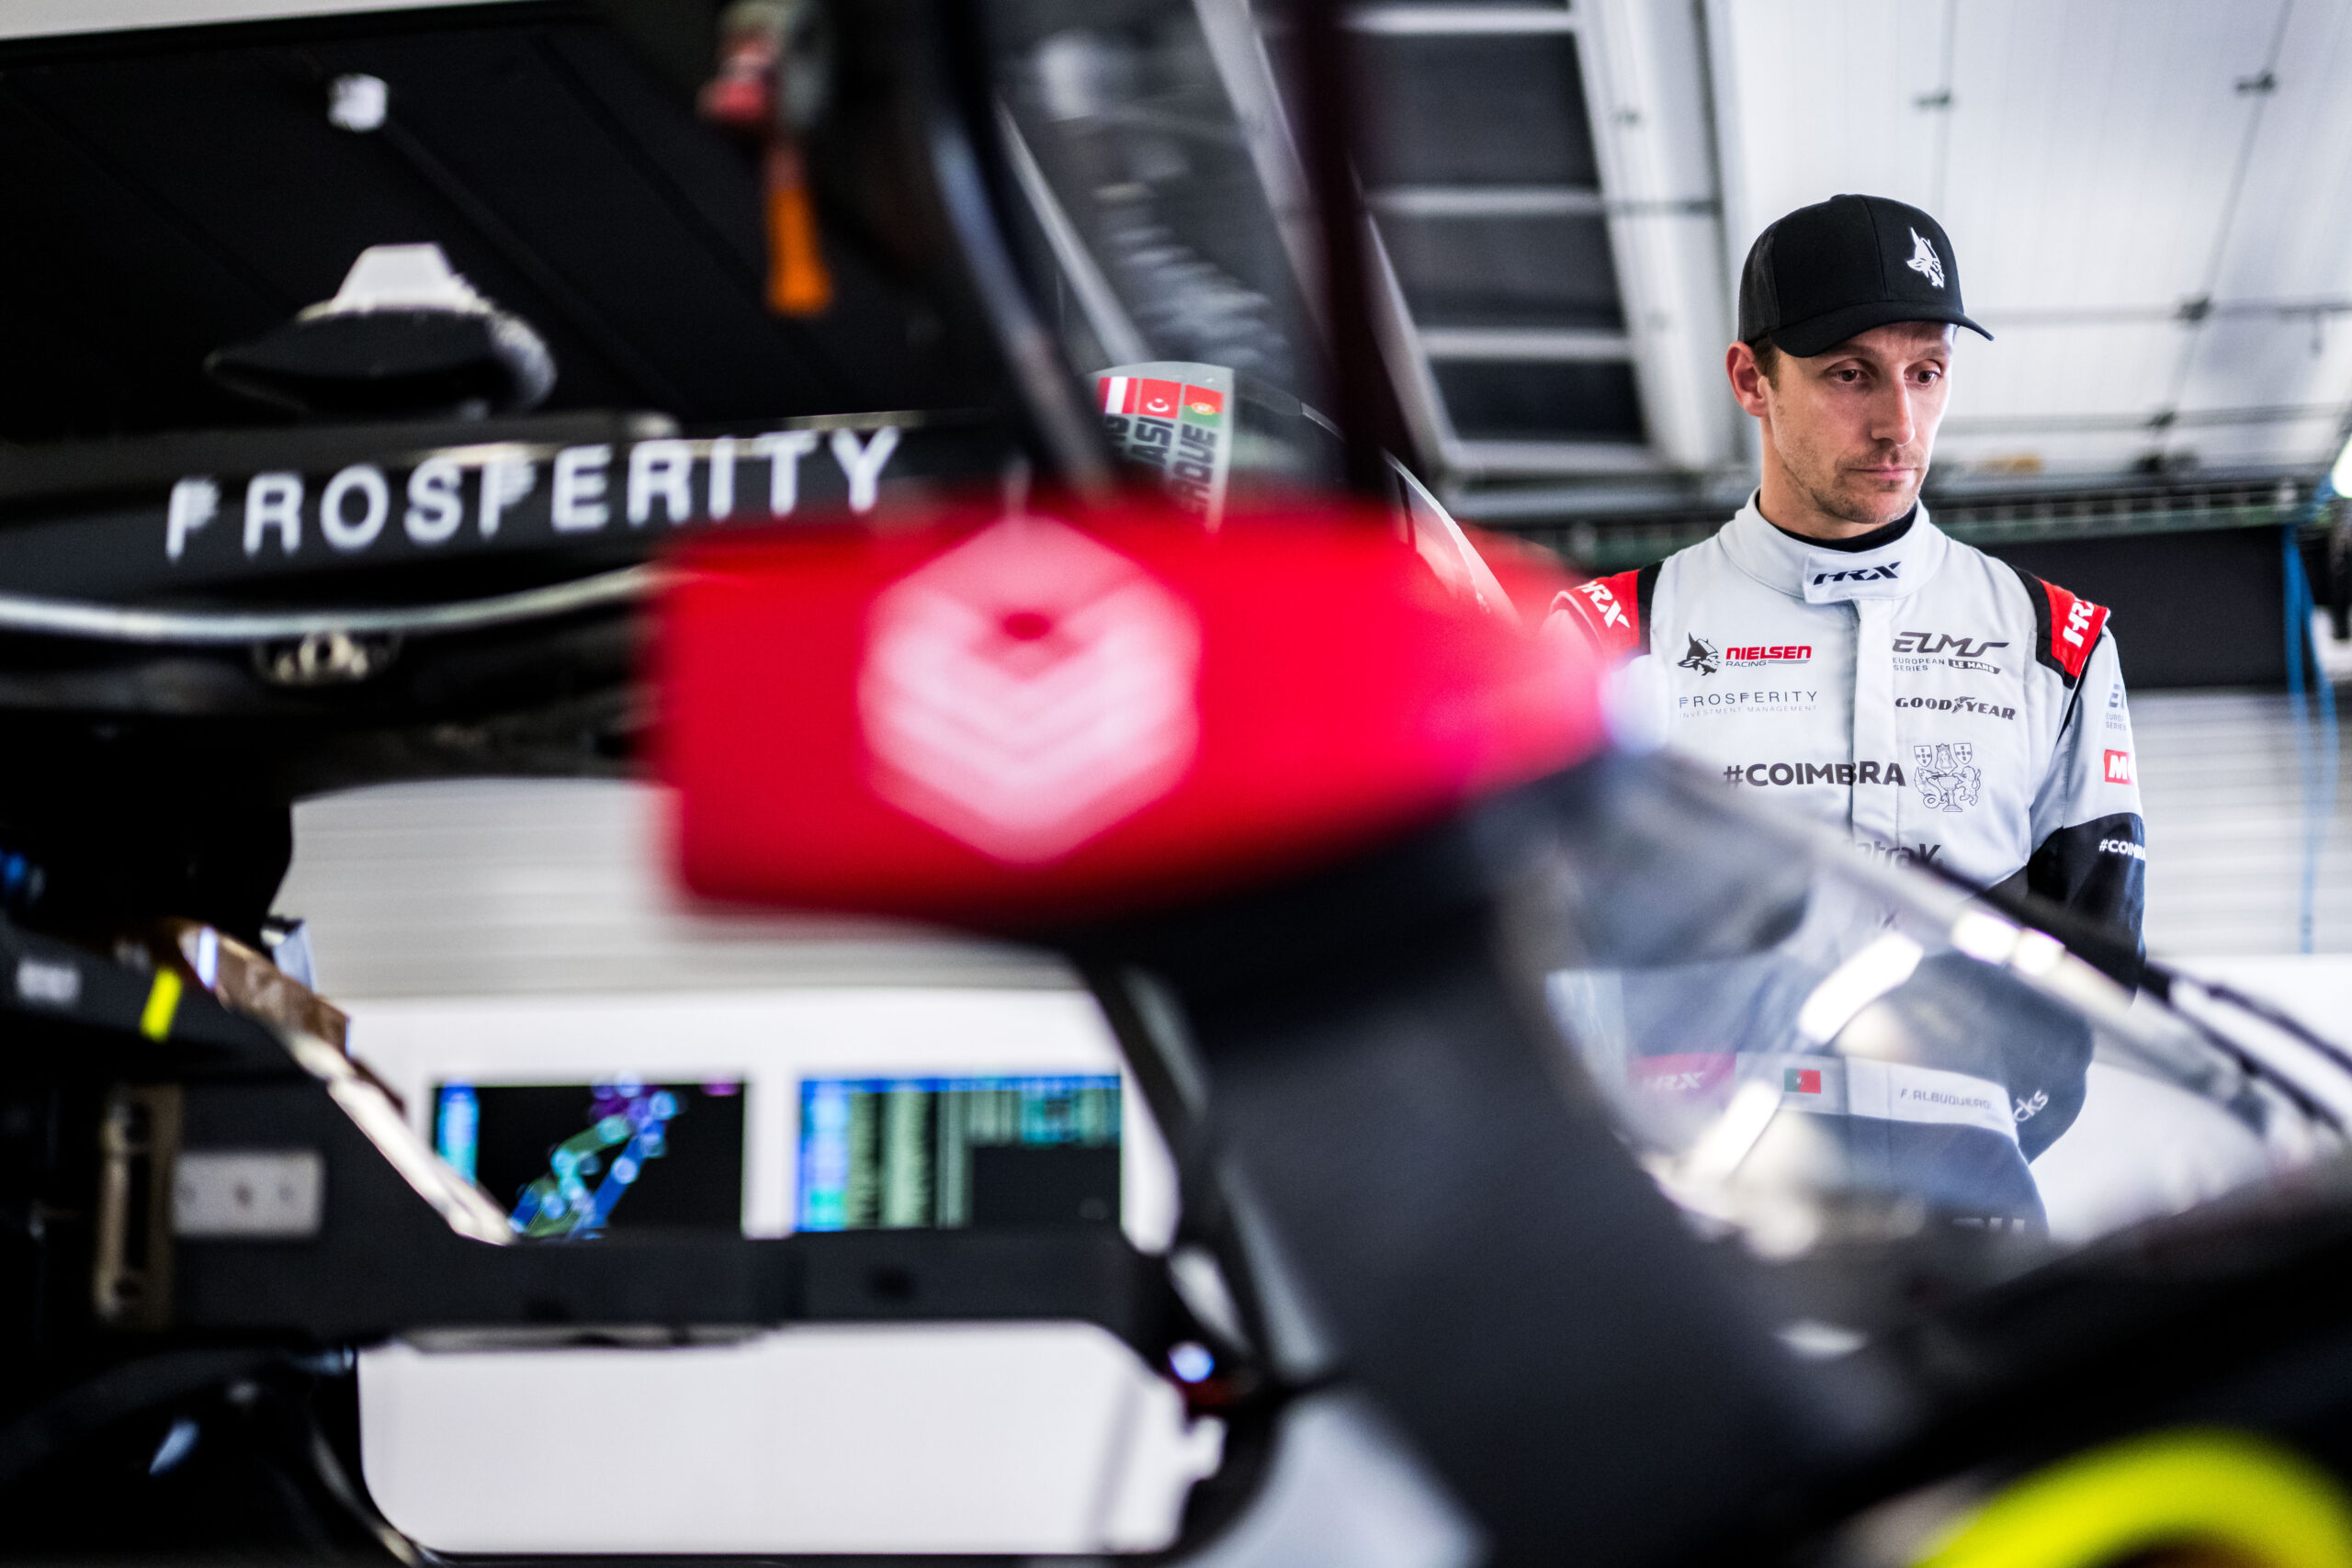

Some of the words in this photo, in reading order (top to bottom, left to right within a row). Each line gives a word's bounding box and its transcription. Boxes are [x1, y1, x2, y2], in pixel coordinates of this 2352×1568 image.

[165, 426, 900, 558] PROSPERITY
[1813, 561, 1901, 585] HRX
[1725, 646, 1812, 660] NIELSEN
[1892, 631, 2009, 658] ELMS
[1893, 657, 1945, 665] EUROPEAN
[1967, 661, 1995, 674] MANS
[1679, 691, 1817, 708] PROSPERITY
[1679, 707, 1742, 719] INVESTMENT
[1747, 705, 1817, 714] MANAGEMENT
[1723, 761, 1906, 786] #COIMBRA
